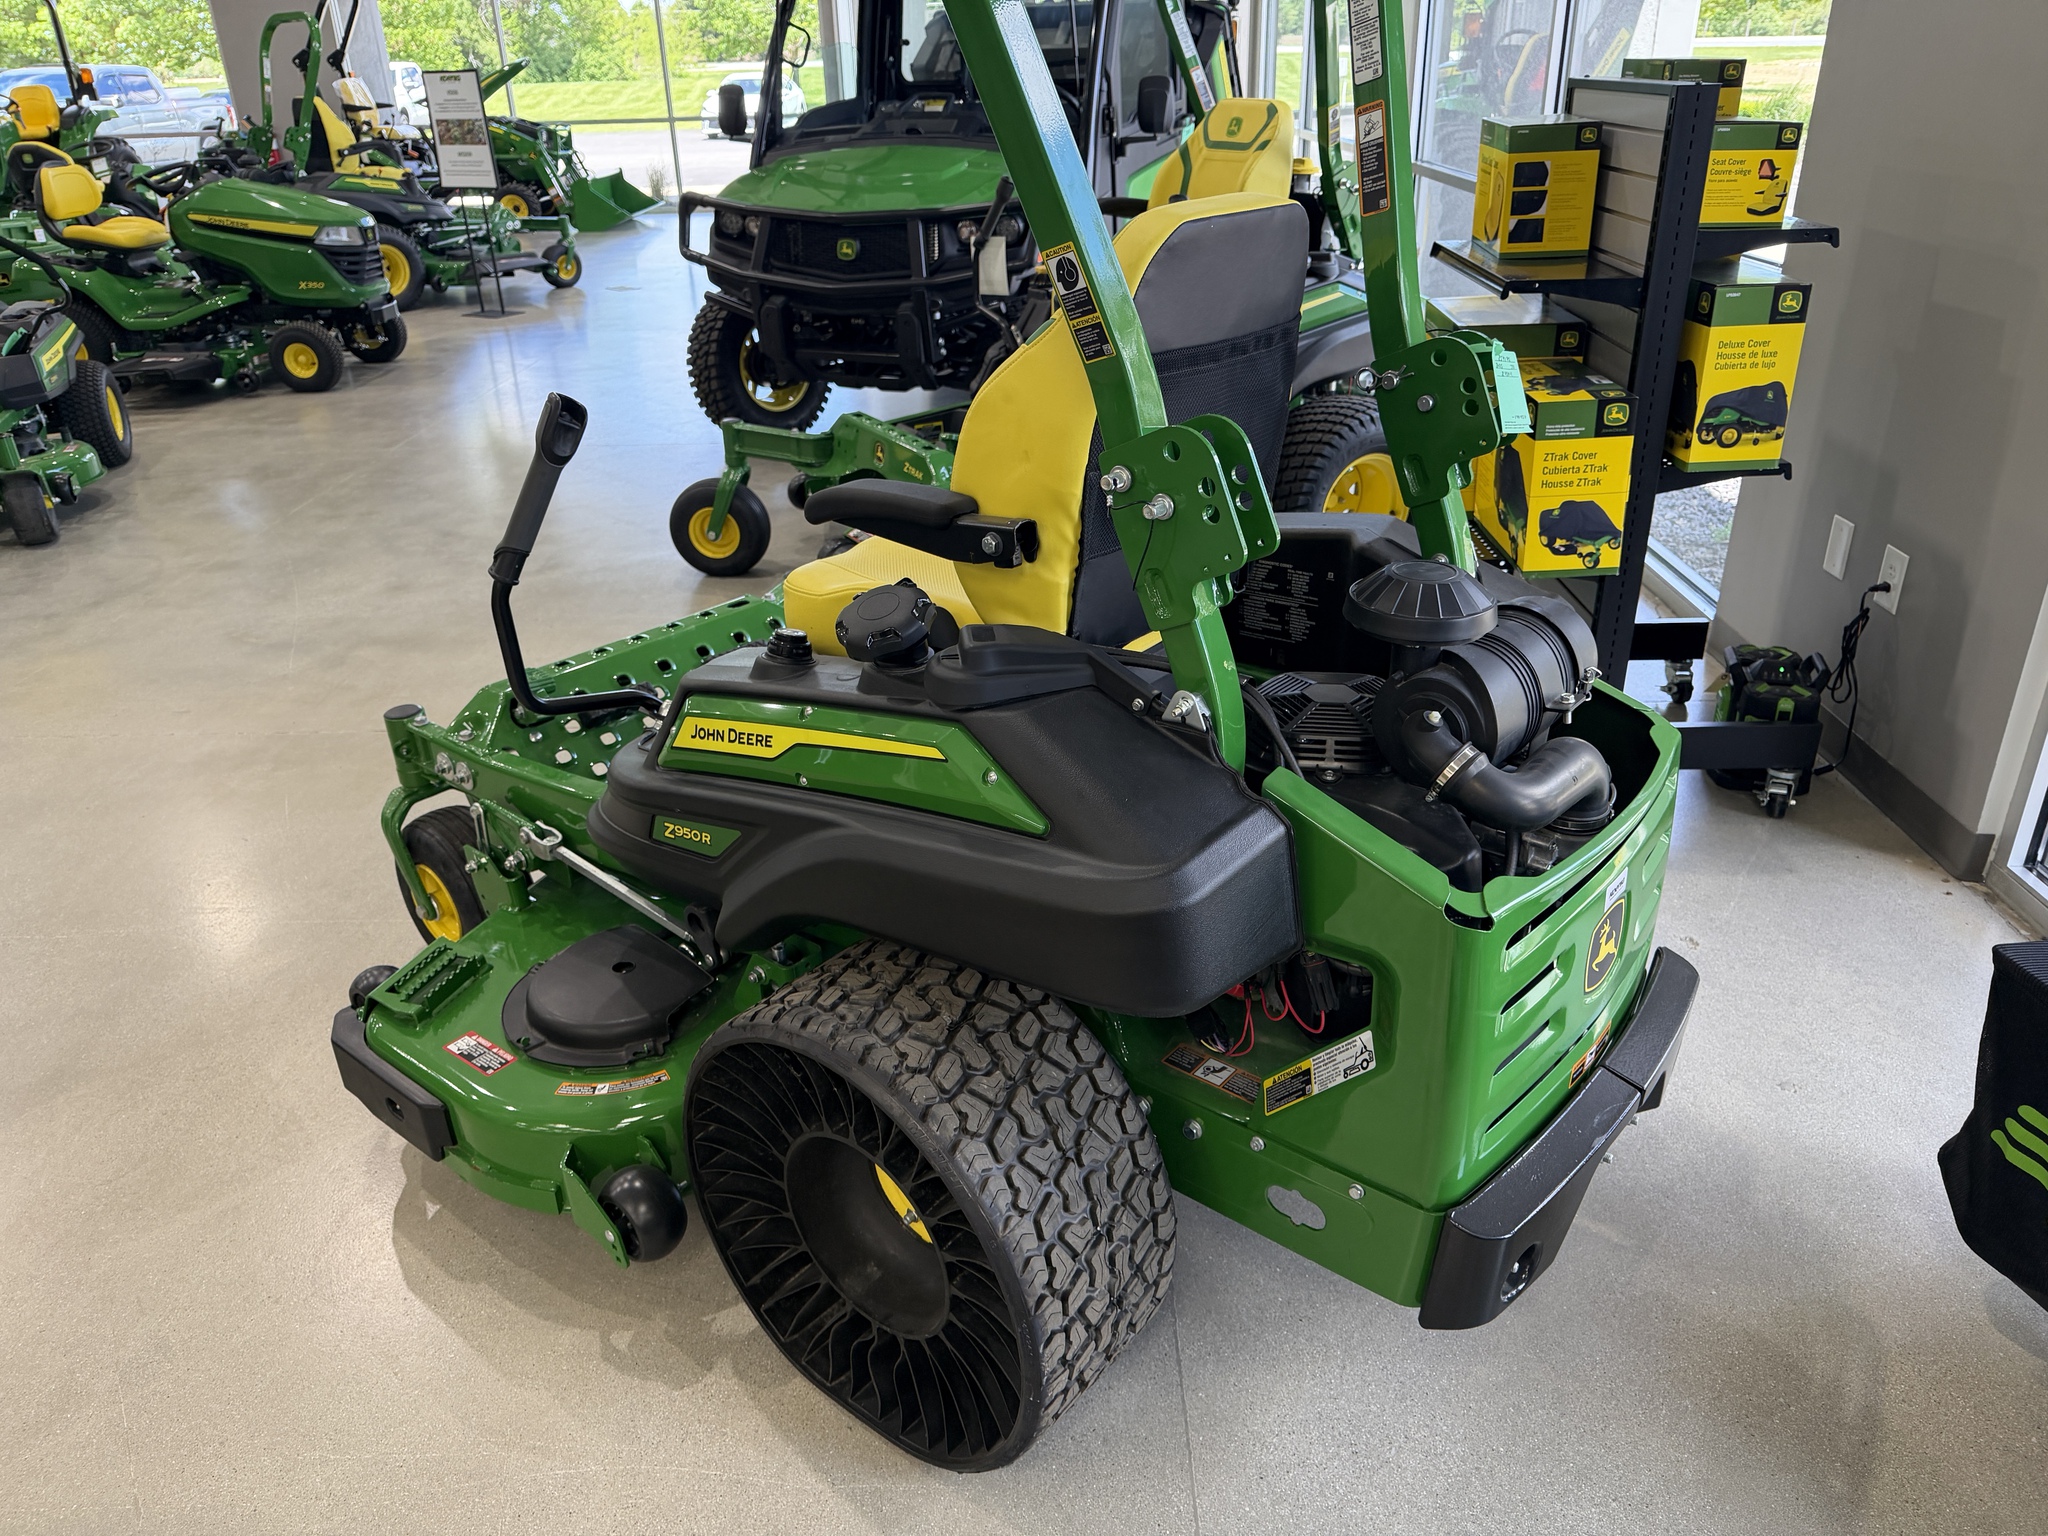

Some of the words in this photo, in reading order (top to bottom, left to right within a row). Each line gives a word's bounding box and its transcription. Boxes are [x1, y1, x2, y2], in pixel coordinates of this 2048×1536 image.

[1710, 168, 1752, 176] Couvre-siège
[1049, 244, 1072, 257] CAUTION
[298, 281, 324, 290] X350
[1718, 340, 1745, 349] Deluxe
[1748, 339, 1771, 348] Cover
[1716, 351, 1746, 360] Housse
[1749, 351, 1758, 359] de
[1761, 350, 1778, 358] luxe
[1714, 362, 1747, 370] Cubierta
[1749, 361, 1759, 369] de
[1762, 360, 1776, 370] lujo
[1544, 453, 1569, 462] ZTrak
[1572, 452, 1598, 460] Cover
[1542, 466, 1580, 475] Cubierta
[1583, 464, 1608, 473] ZTrak
[1541, 480, 1574, 488] Housse
[1576, 478, 1601, 487] ZTrak
[691, 724, 725, 742] JOHN
[728, 728, 773, 748] DEERE
[1277, 1065, 1303, 1083] ATENCIÓN
